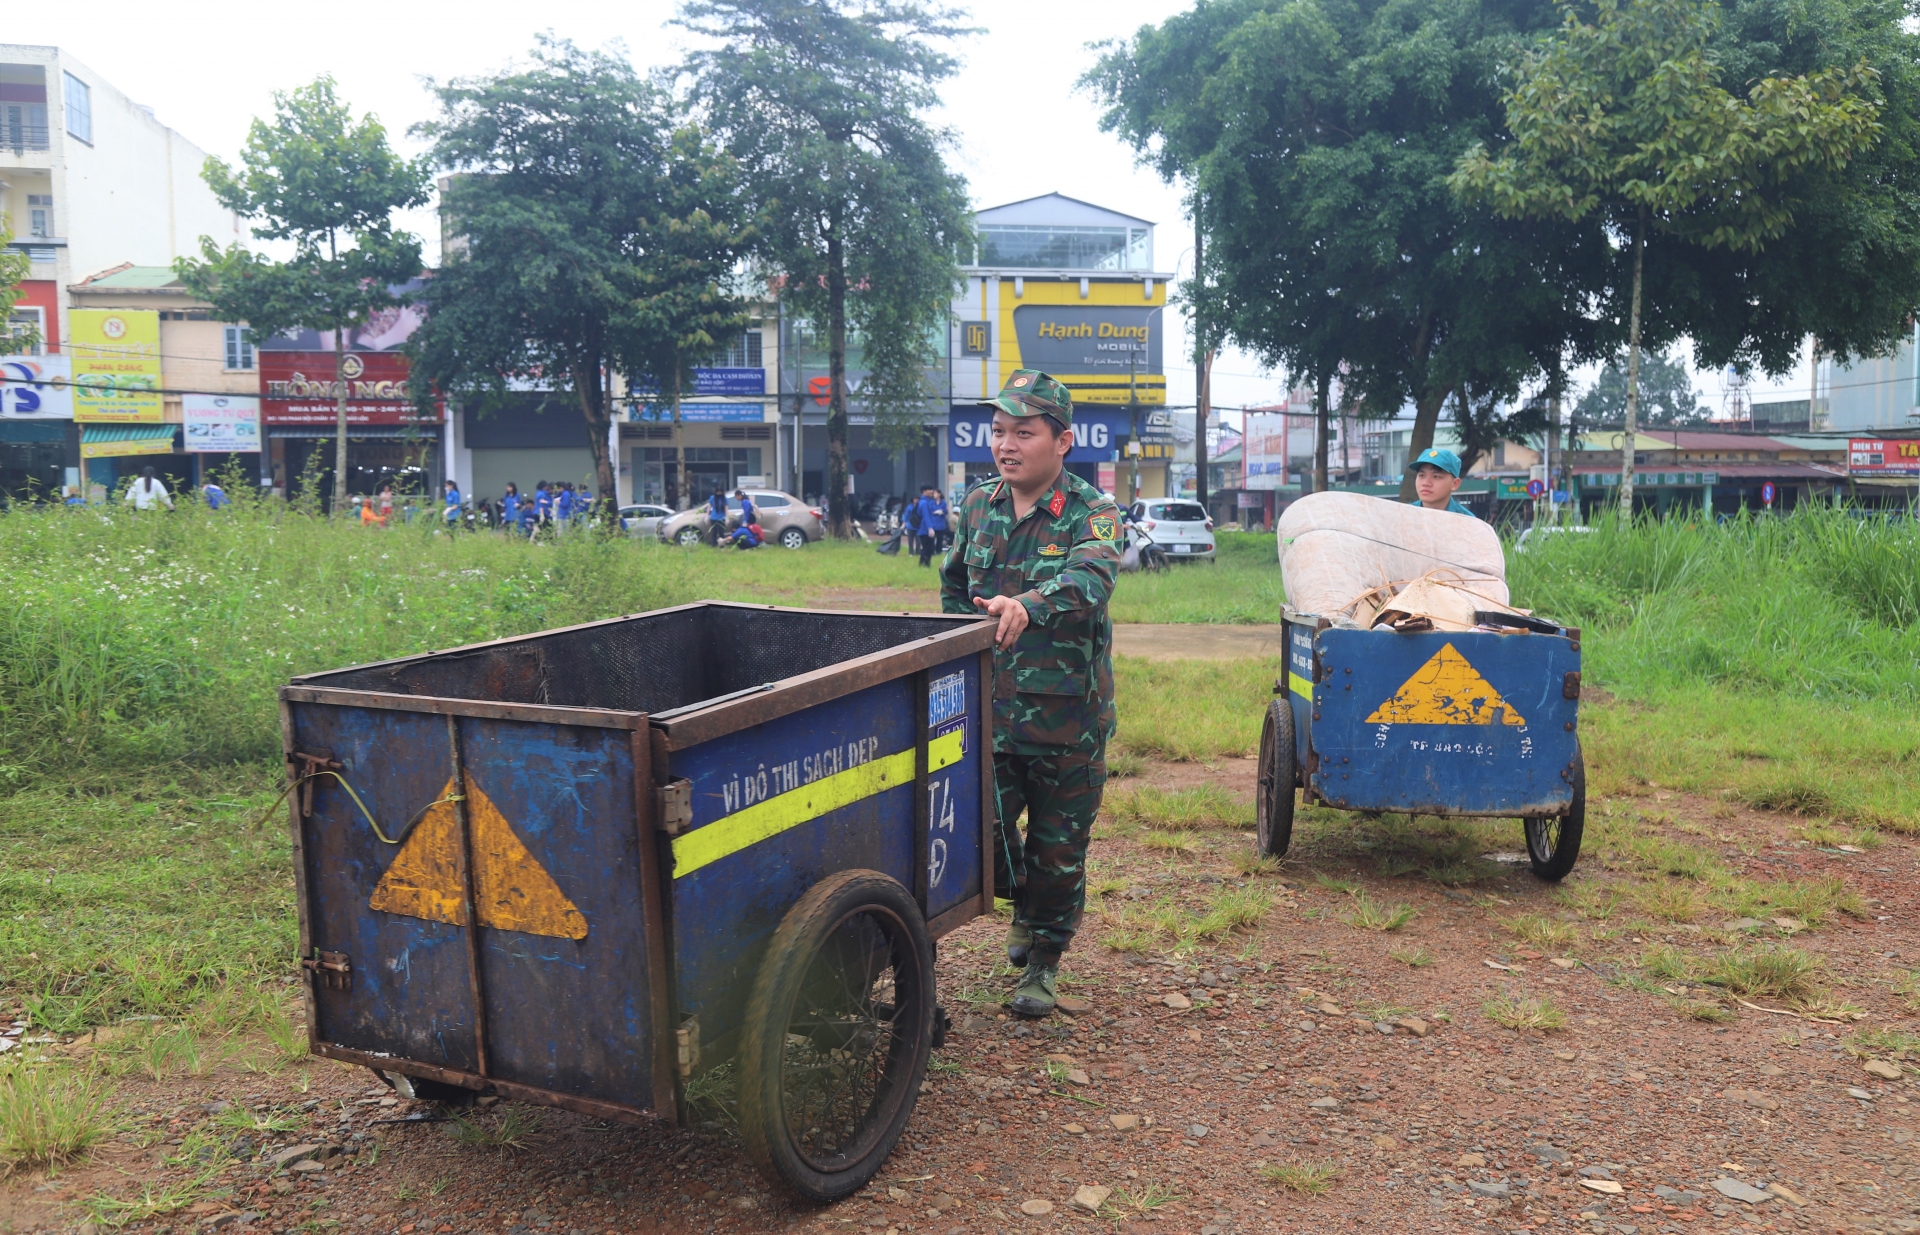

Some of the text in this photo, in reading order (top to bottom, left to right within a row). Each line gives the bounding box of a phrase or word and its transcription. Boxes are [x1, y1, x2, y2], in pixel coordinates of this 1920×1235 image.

[1039, 322, 1149, 342] Hạnh Dung
[267, 371, 349, 400] HỒNG
[955, 422, 1108, 448] SANG
[722, 772, 740, 813] VÌ
[744, 763, 768, 806] ĐÔ
[928, 777, 955, 832] T4
